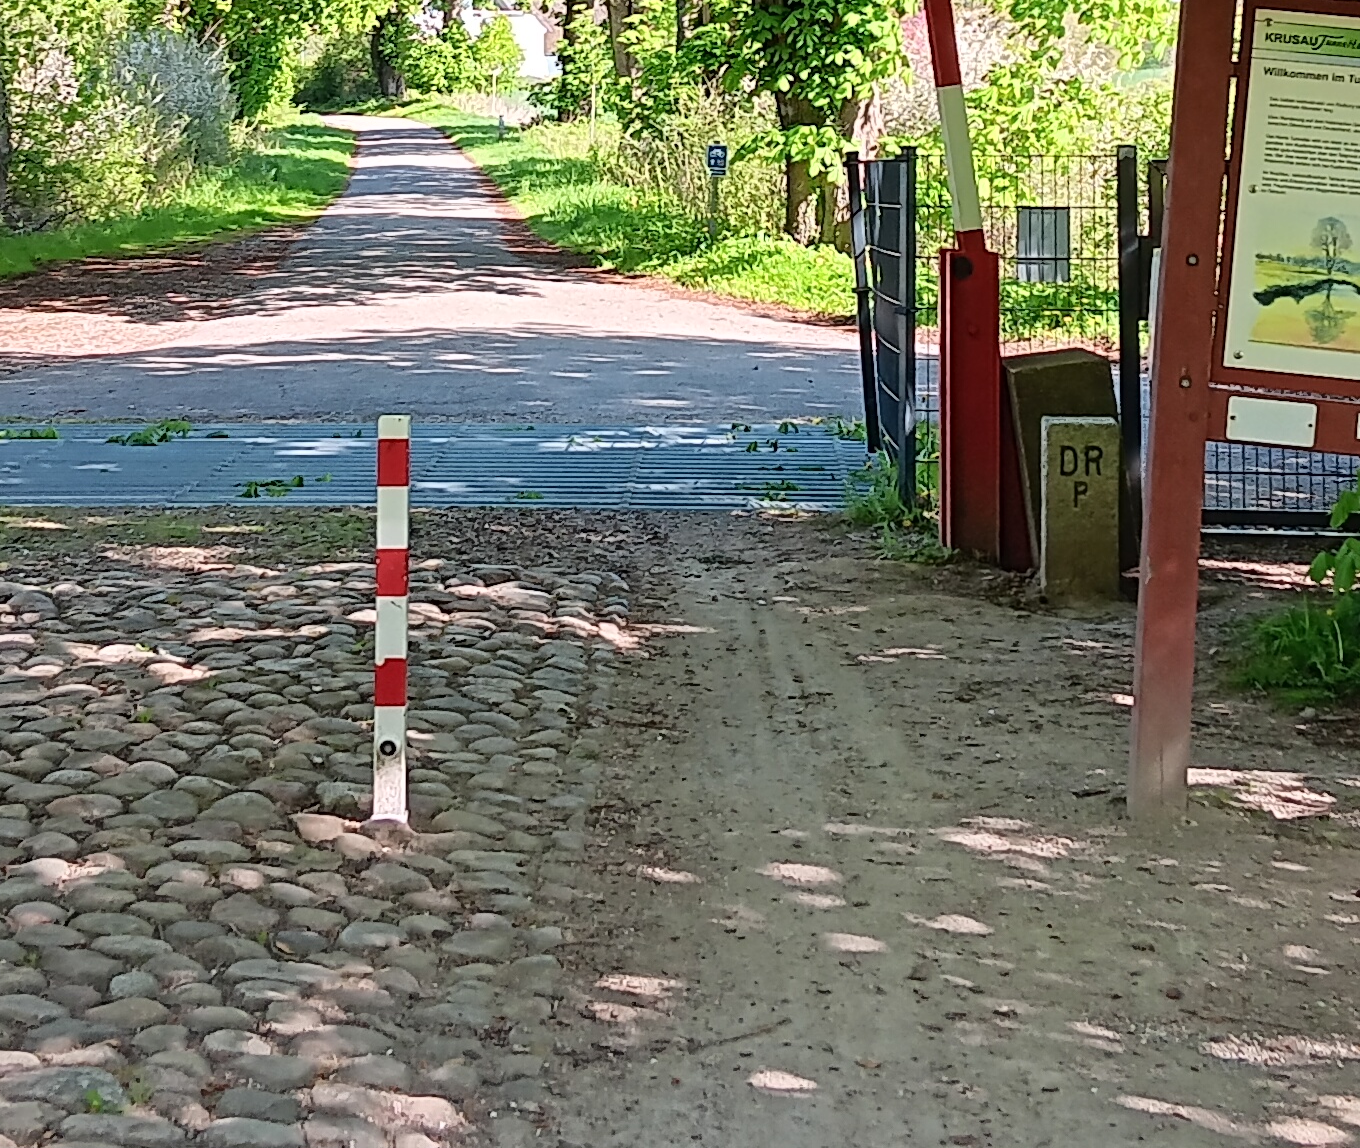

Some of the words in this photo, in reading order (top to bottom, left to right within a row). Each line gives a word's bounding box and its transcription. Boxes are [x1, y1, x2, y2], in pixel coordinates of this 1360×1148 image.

[1264, 32, 1318, 47] KRUSAU
[1263, 66, 1329, 83] Willkommen
[1331, 73, 1345, 83] im
[1059, 444, 1104, 477] DR
[1073, 480, 1088, 508] P
